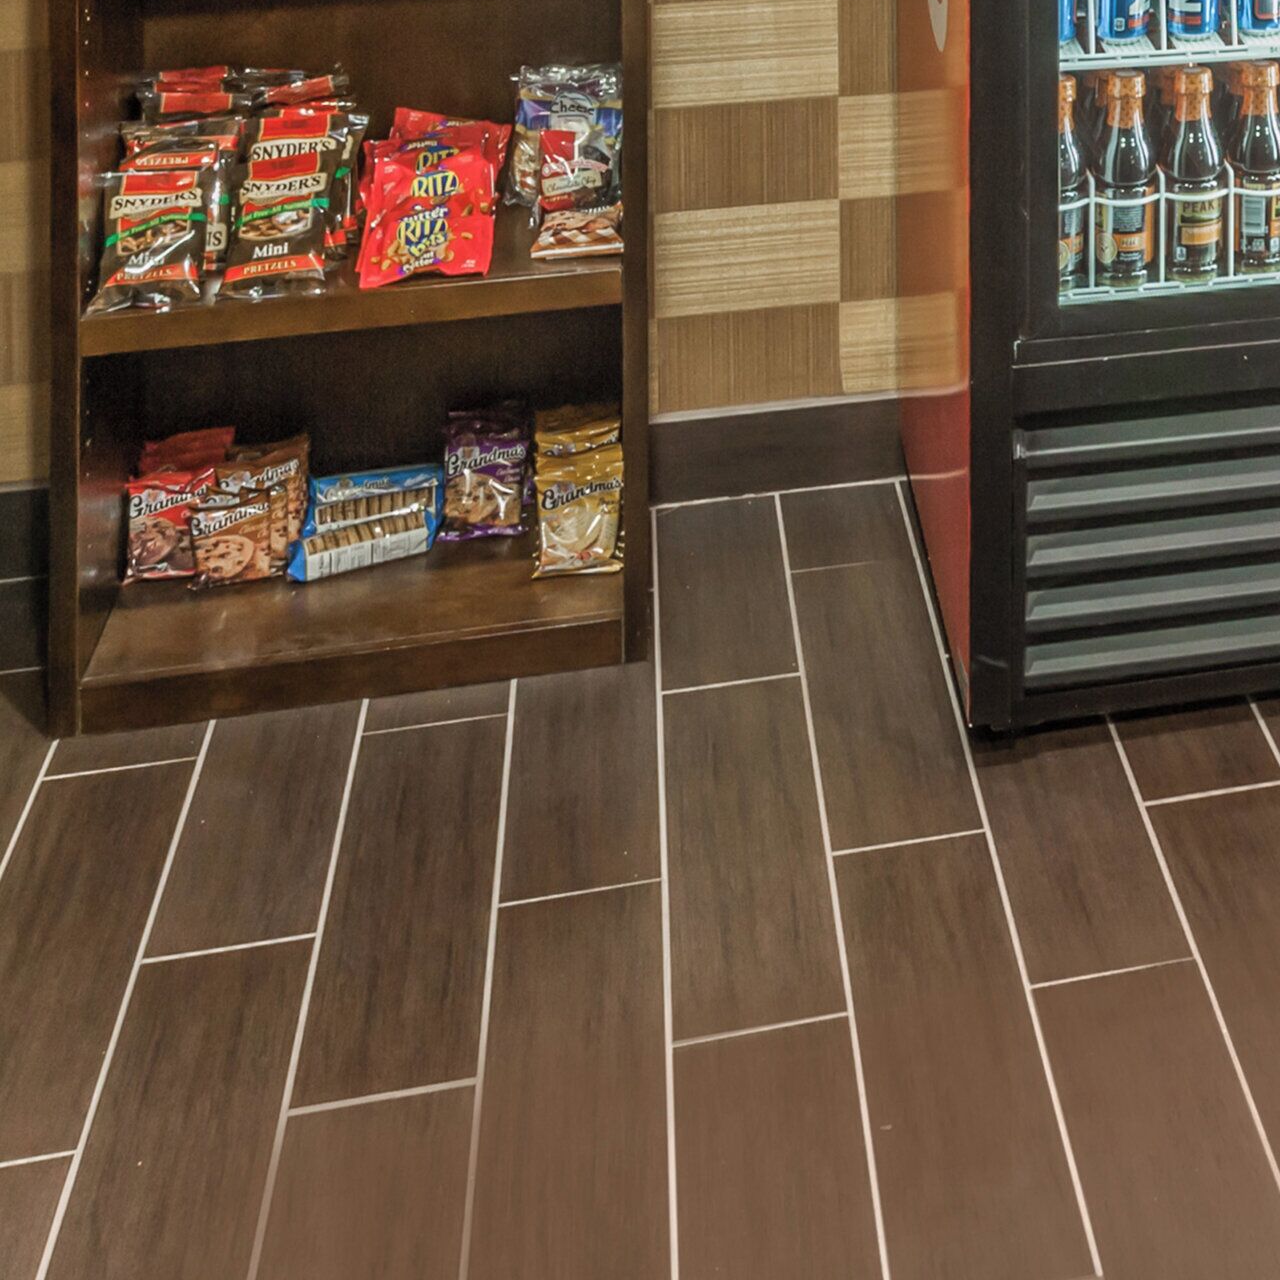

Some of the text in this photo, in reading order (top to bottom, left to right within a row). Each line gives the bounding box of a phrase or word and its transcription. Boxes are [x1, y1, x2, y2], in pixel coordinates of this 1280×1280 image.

[550, 100, 595, 116] Cheese
[241, 174, 322, 197] SNYDER'S
[412, 172, 459, 198] RITZ
[1182, 199, 1215, 213] PEAK
[400, 219, 446, 247] RITZ
[253, 243, 289, 260] Mini
[243, 259, 297, 275] PRETZELS
[448, 445, 526, 477] Grandma's
[541, 477, 623, 510] Grandma's
